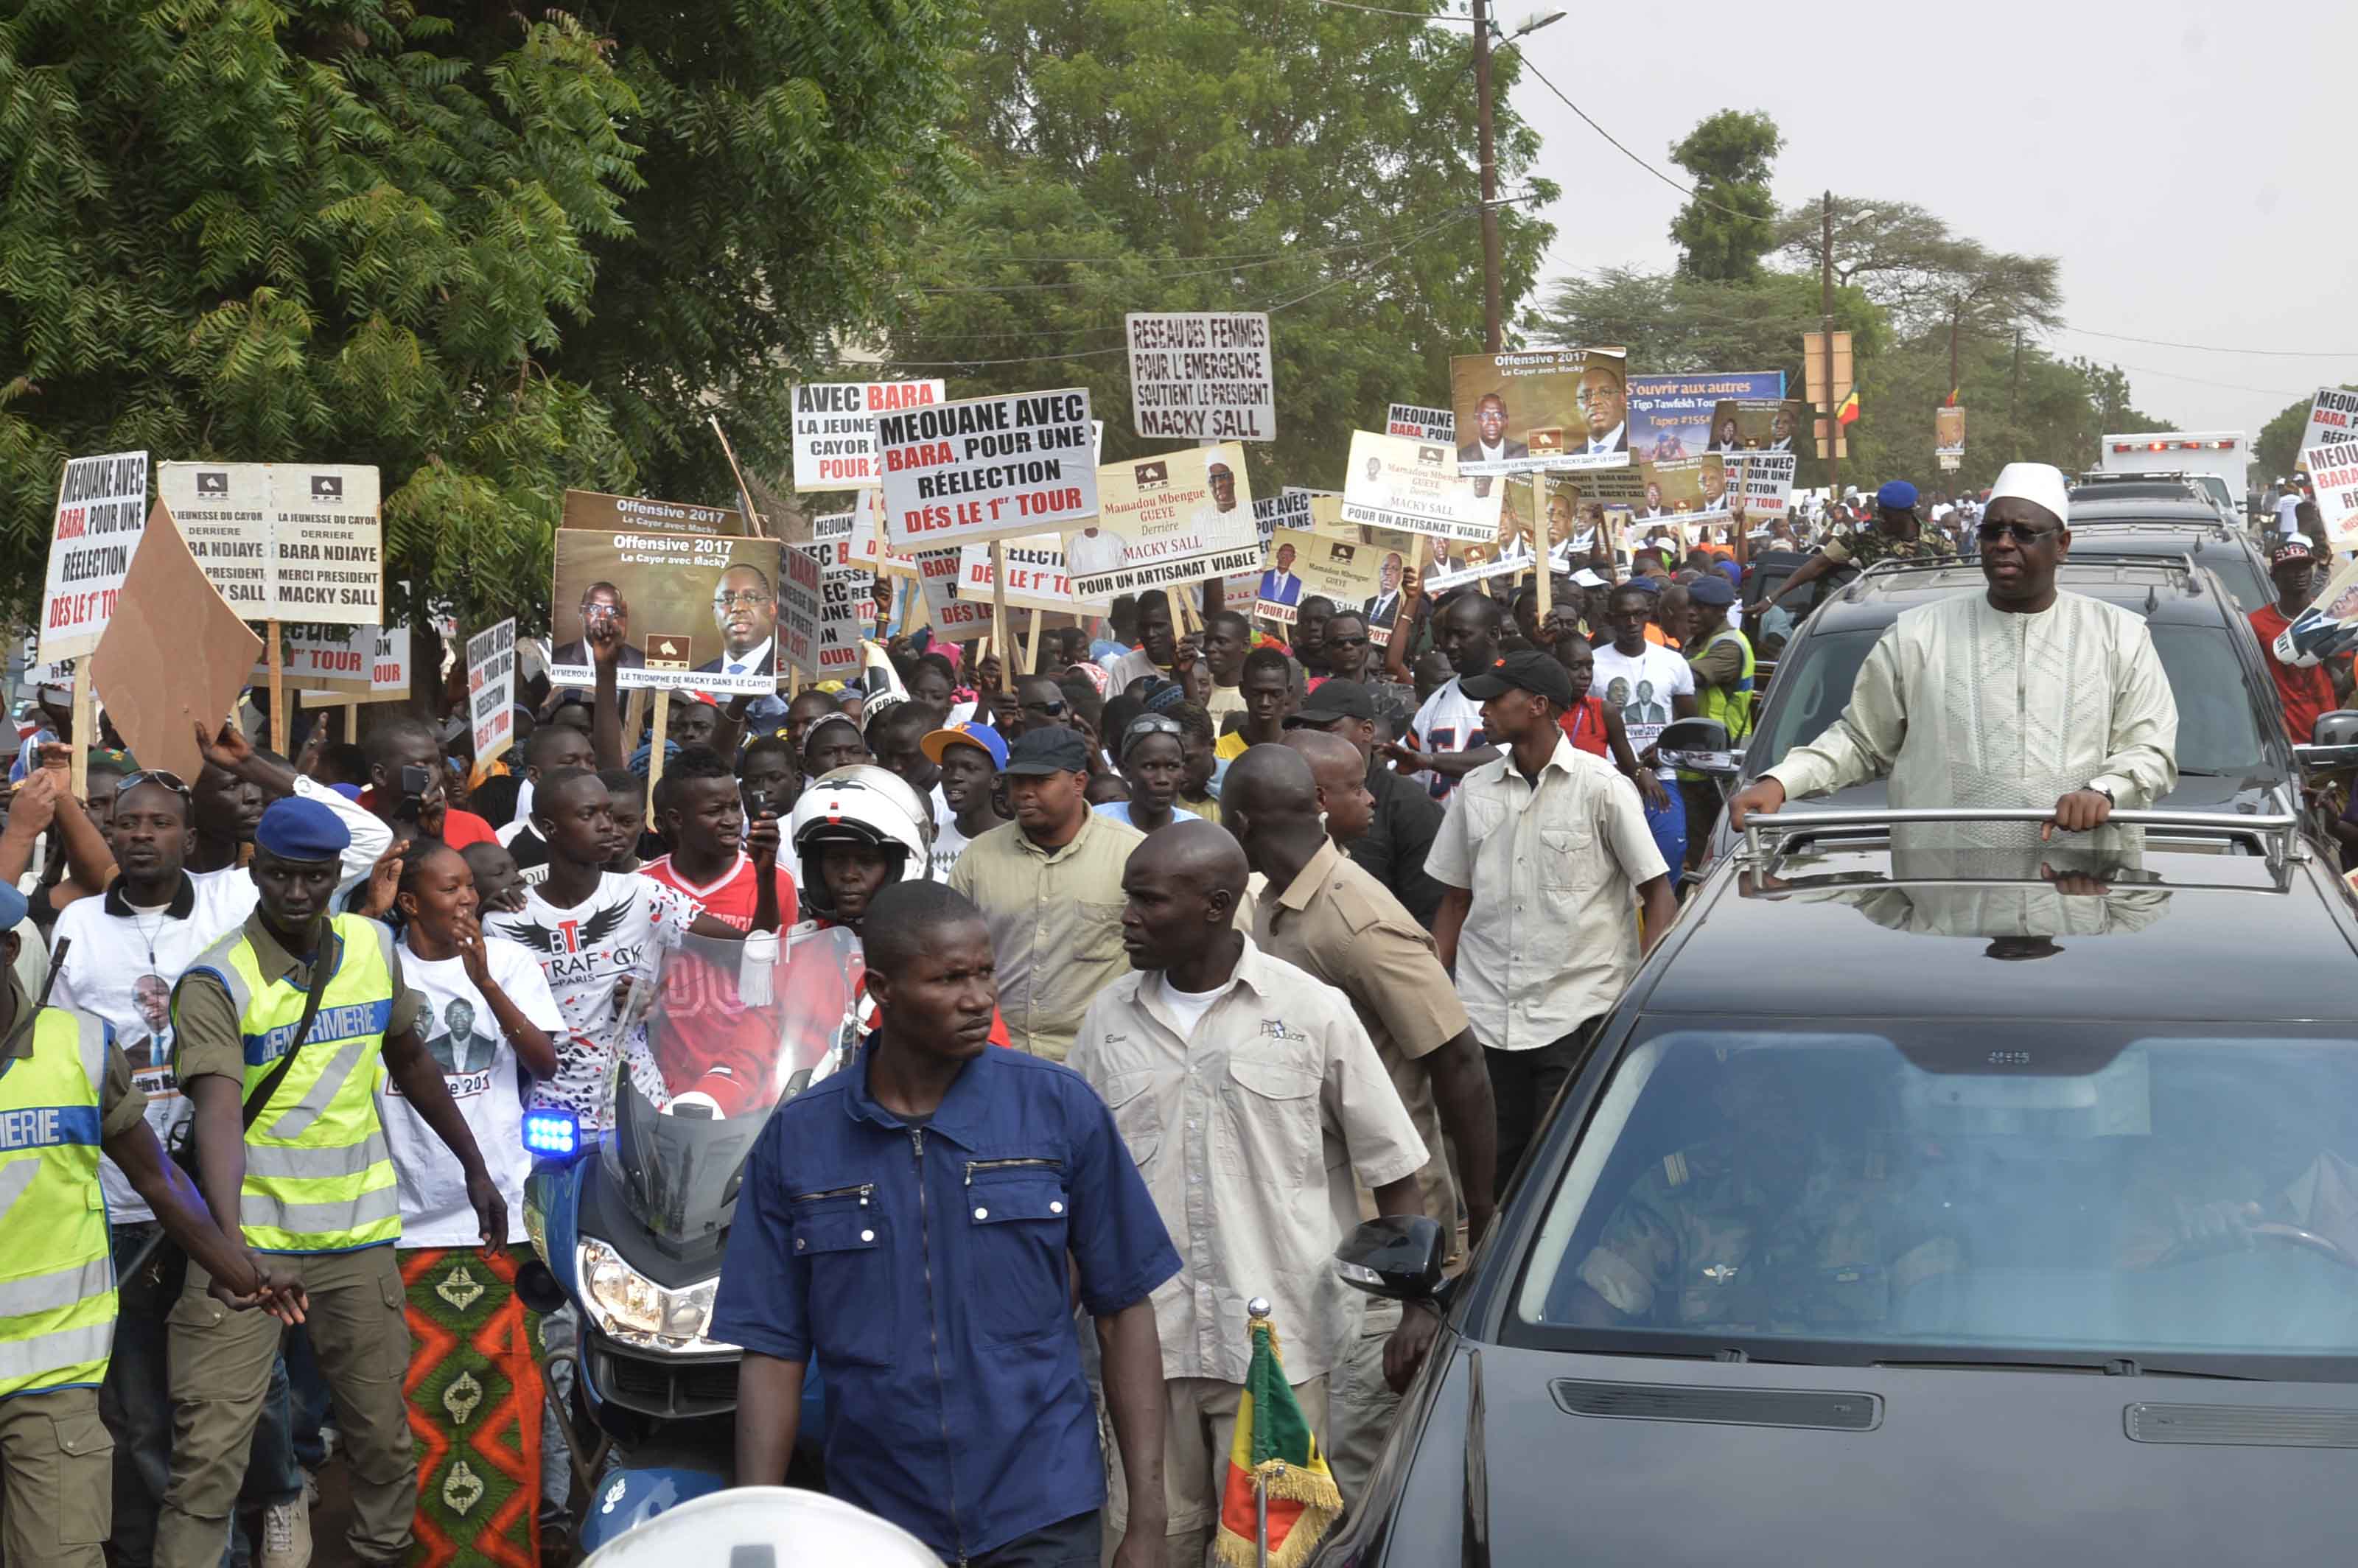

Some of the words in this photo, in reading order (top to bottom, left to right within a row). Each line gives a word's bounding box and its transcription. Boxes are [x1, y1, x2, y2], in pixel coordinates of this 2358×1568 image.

[1133, 319, 1183, 349] RESEAU
[1186, 319, 1206, 348] DES
[1211, 319, 1264, 348] FEMMES
[1135, 354, 1170, 381] POUR
[1495, 354, 1554, 366] Offensive
[1558, 351, 1587, 363] 2017
[1138, 384, 1193, 407] SOUTIENT
[1197, 384, 1209, 405] LE
[1211, 383, 1269, 405] PRESIDENT
[1626, 382, 1679, 395] S'ouvrir
[1681, 385, 1706, 394] aux
[1709, 382, 1751, 393] autres
[798, 386, 860, 413] AVEC
[867, 384, 934, 410] BARA
[1633, 399, 1654, 410] Tigo
[798, 419, 819, 434] LA
[823, 419, 875, 434] JEUNE
[879, 402, 1010, 447] MEOUANE
[1015, 394, 1084, 427] AVEC
[1141, 410, 1206, 435] MACKY
[1212, 410, 1260, 436] SALL
[1391, 406, 1452, 428] MEOUANE
[811, 439, 868, 455] CAYOR
[886, 442, 959, 472] BARA,
[964, 432, 1032, 460] POUR
[1038, 426, 1085, 450] UNE
[819, 458, 870, 479] POUR
[1764, 457, 1794, 469] AVEC
[114, 457, 144, 497] AVEC
[917, 459, 1061, 499] RÉELECTION
[1413, 478, 1439, 489] GUEYE
[1748, 469, 1768, 479] OUR
[1771, 471, 1791, 481] UNE
[905, 504, 951, 533] DÉS
[957, 501, 982, 525] LE
[987, 496, 1010, 520] 1er
[1015, 488, 1082, 516] TOUR
[1105, 499, 1156, 514] Mamadou
[1158, 489, 1206, 507] Mbengue
[1277, 493, 1308, 517] AVEC
[1391, 497, 1427, 511] MACKY
[1430, 503, 1454, 516] SALL
[1757, 497, 1783, 508] TOUR
[88, 504, 118, 535] POUR
[119, 501, 141, 531] UNE
[177, 511, 220, 520] JEUNESSE
[220, 511, 233, 520] DU
[234, 512, 262, 521] CAYOR
[279, 513, 288, 522] LA
[290, 513, 332, 524] JEUNESSE
[335, 515, 346, 525] DU
[348, 516, 377, 525] CAYOR
[616, 500, 685, 519] Offensive
[690, 510, 725, 525] 2017
[1140, 507, 1175, 522] GUEYE
[1288, 513, 1310, 528] UNE
[1348, 508, 1375, 519] POUR
[1379, 514, 1393, 523] UN
[1394, 518, 1452, 535] ARTISANAT
[189, 528, 241, 536] DERRIERE
[301, 530, 354, 539] DERRIERE
[816, 516, 854, 536] MEOUAN
[1141, 520, 1179, 536] Derrière
[189, 542, 208, 557] RA
[211, 542, 262, 558] NDIAYE
[279, 543, 320, 560] BARA
[323, 545, 377, 562] NDIAYE
[614, 535, 690, 552] Offensive
[694, 539, 733, 553] 2017
[1123, 540, 1168, 560] MACKY
[1172, 536, 1203, 553] SALL
[621, 553, 634, 561] Le
[637, 554, 665, 565] Cayor
[668, 556, 690, 565] avec
[694, 555, 728, 568] Macky
[922, 557, 959, 578] BAR
[206, 567, 264, 579] PRESIDENT
[279, 569, 313, 581] MERCI
[317, 570, 379, 584] PRESIDENT
[971, 563, 993, 584] DÉ
[1009, 569, 1027, 588] LE
[1054, 574, 1071, 595] TO
[1078, 576, 1113, 595] POUR
[1116, 573, 1134, 588] UN
[1137, 560, 1206, 586] ARTISANAT
[1211, 552, 1256, 575] VIABLE
[229, 584, 265, 601] SALL
[279, 586, 336, 603] MACKY
[340, 588, 377, 606] SALL
[72, 594, 85, 625] LE
[102, 587, 121, 620] TO
[1257, 603, 1282, 617] POUR
[1285, 610, 1297, 621] LA
[310, 650, 362, 671] TOUR
[819, 648, 856, 665] OUR
[374, 664, 401, 683] OUR
[621, 672, 630, 680] LE
[632, 673, 671, 684] TRIOMPHE
[672, 676, 682, 684] DE
[684, 676, 710, 685] MACKY
[736, 679, 746, 687] LE
[559, 974, 595, 987] PARIS
